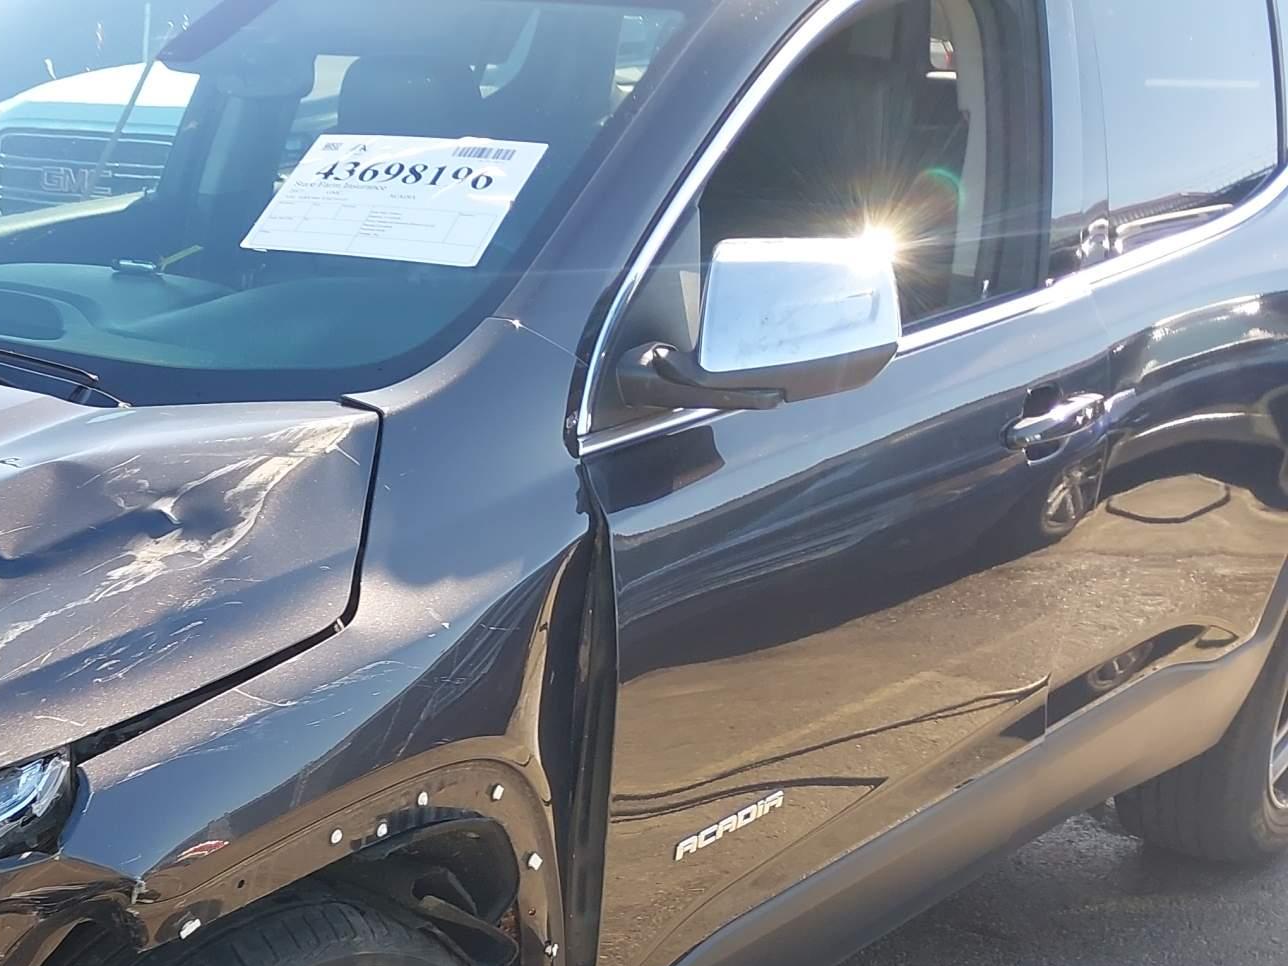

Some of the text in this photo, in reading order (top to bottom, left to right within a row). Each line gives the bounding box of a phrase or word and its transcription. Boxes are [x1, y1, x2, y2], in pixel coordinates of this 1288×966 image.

[41, 166, 112, 195] GMC
[315, 161, 494, 190] 43698196
[674, 790, 784, 862] ACADIA
